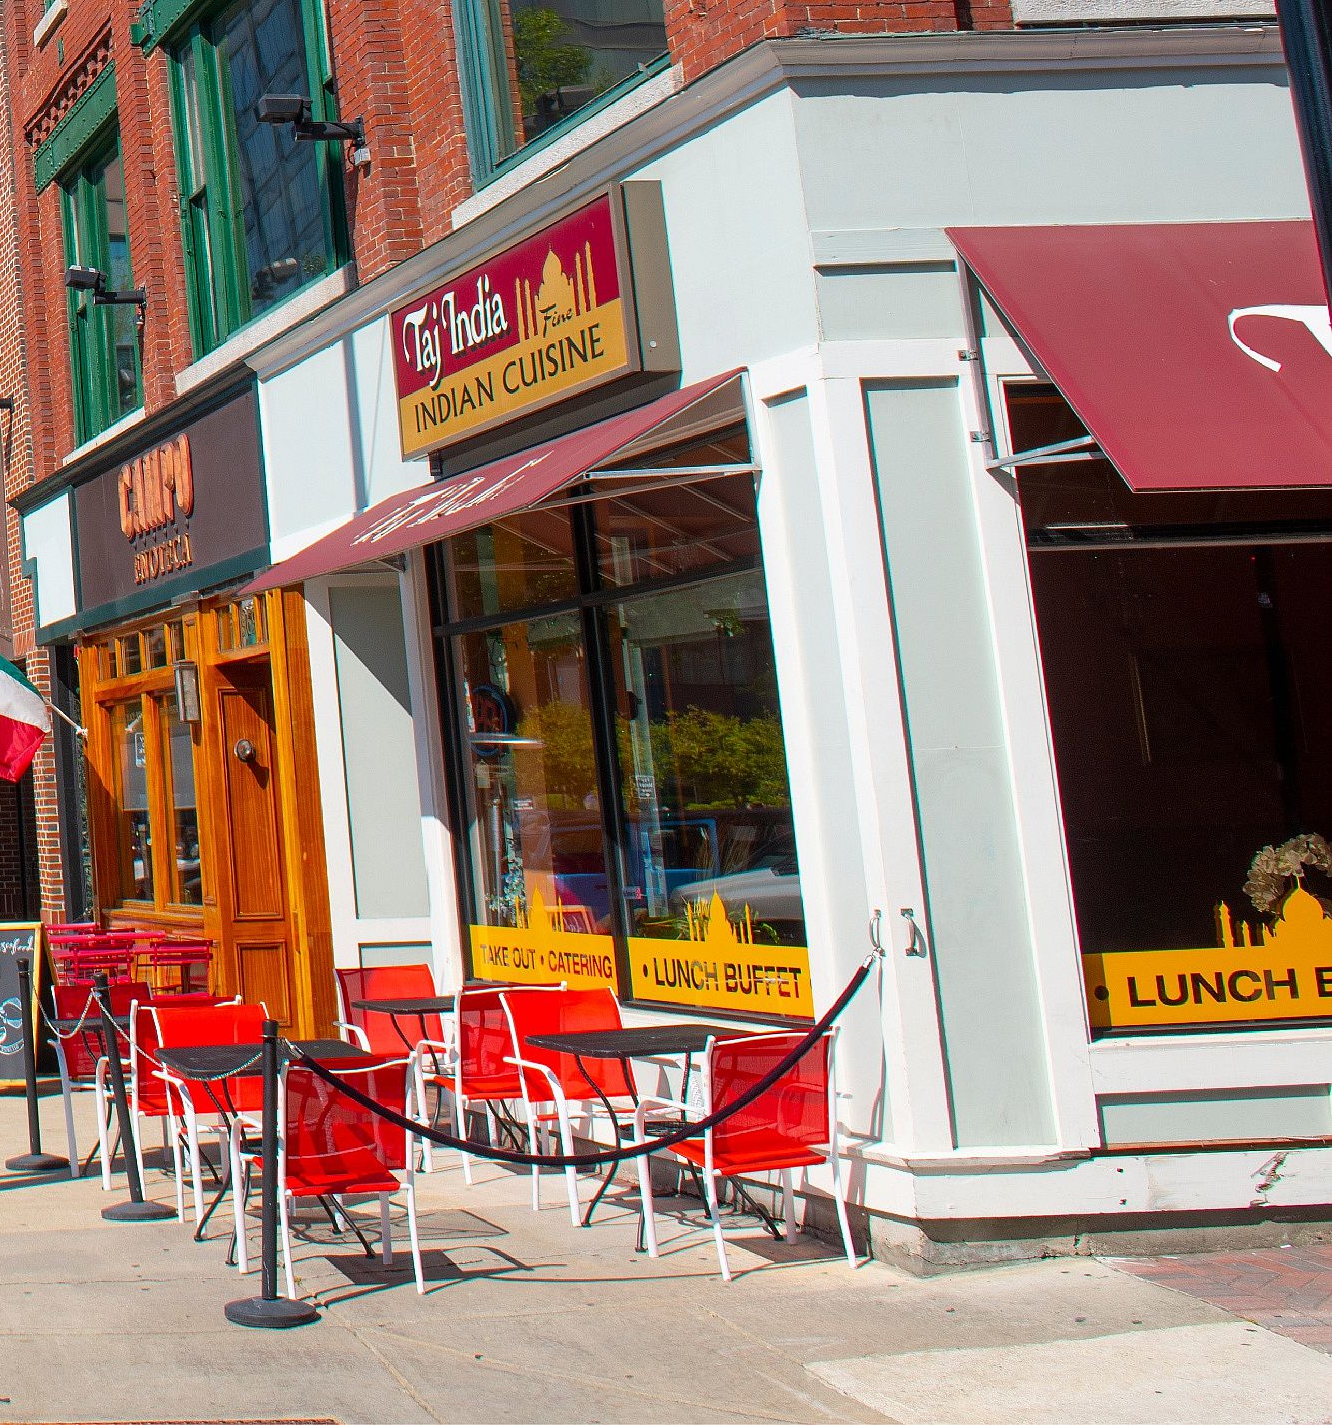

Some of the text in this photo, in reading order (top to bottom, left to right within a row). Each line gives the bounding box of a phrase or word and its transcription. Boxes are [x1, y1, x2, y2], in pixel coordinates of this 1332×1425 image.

[402, 273, 509, 387] Taj India
[539, 303, 574, 338] Fine
[414, 322, 605, 433] INDIAN CUISINE
[134, 532, 193, 585] ENOTECA
[479, 943, 614, 980] TAKE OUT CATERING
[653, 957, 802, 999] LUNCH BUFFET
[1126, 967, 1300, 1008] LUNCH
